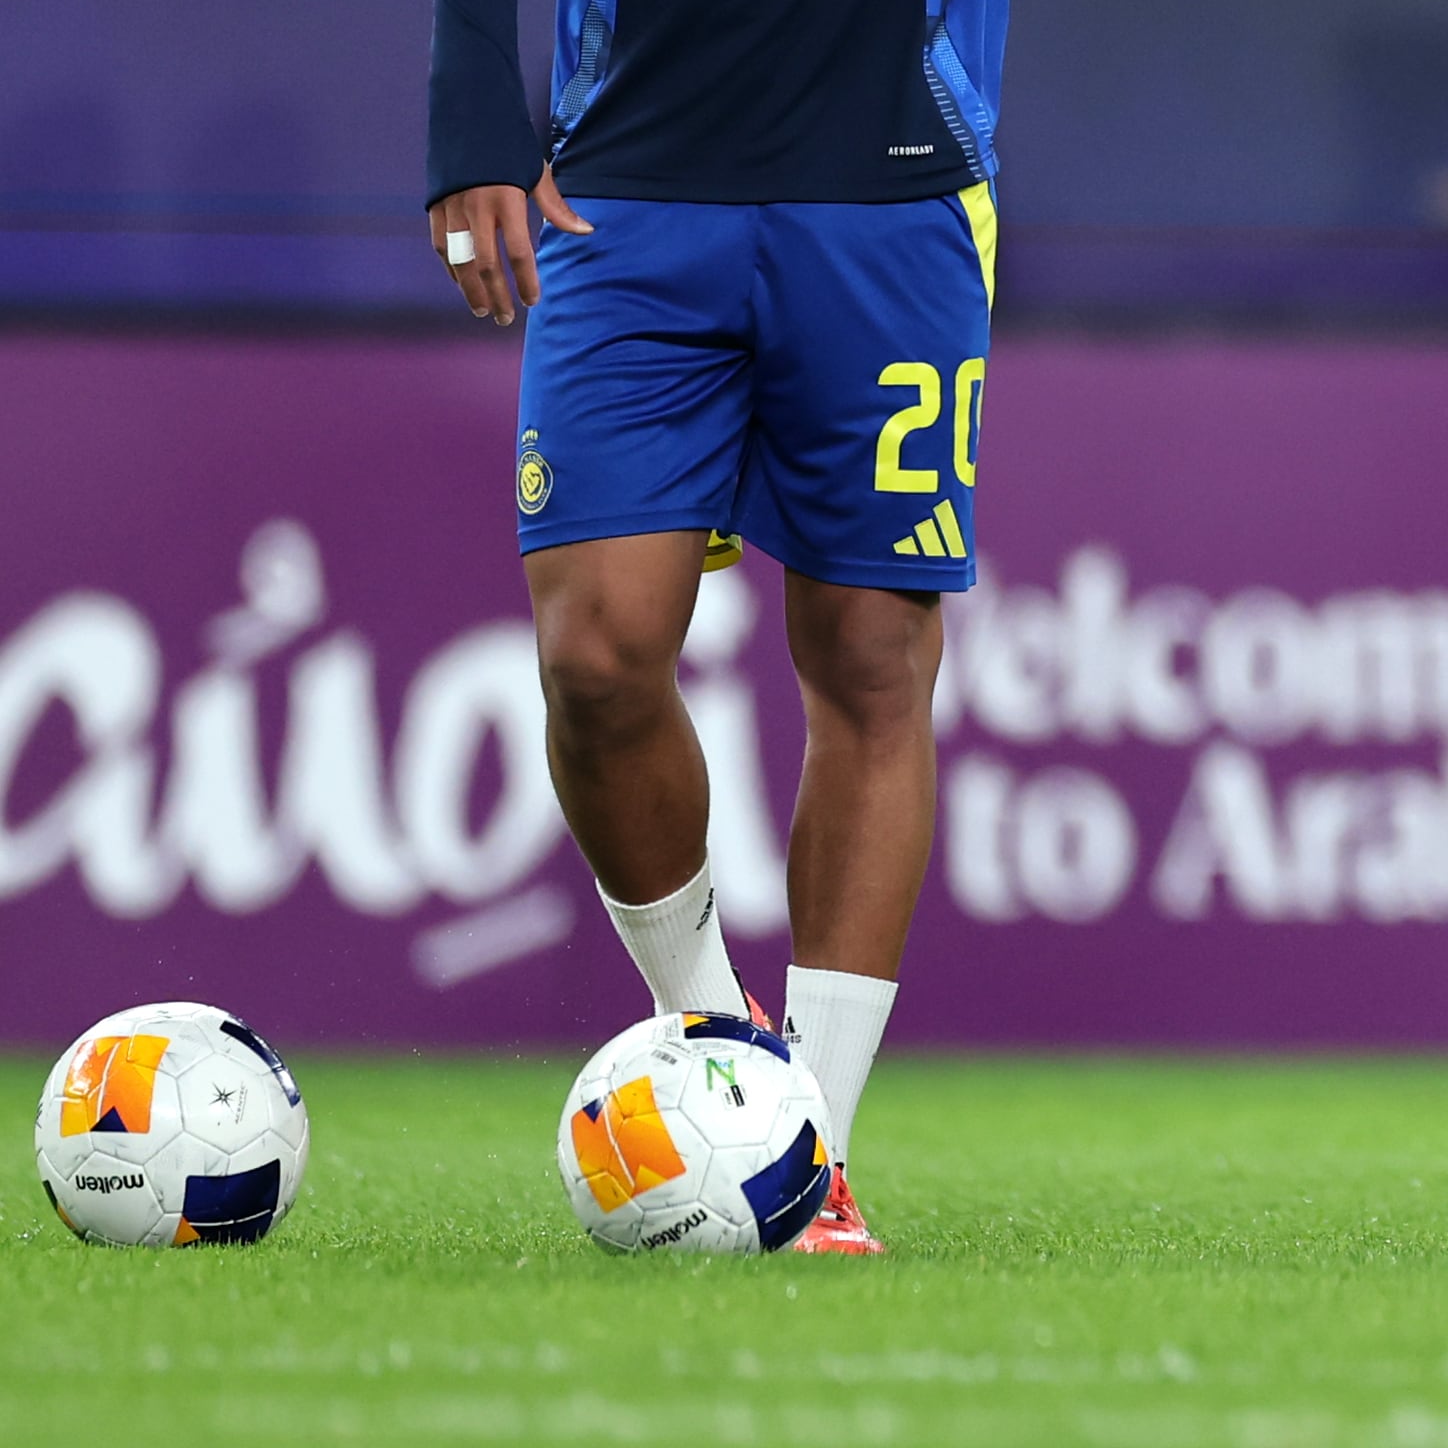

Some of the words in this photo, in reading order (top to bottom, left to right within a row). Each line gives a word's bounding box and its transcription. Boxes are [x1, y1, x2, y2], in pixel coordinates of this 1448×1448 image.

[875, 357, 986, 493] 20
[943, 752, 1137, 924] to
[75, 1173, 145, 1194] molten
